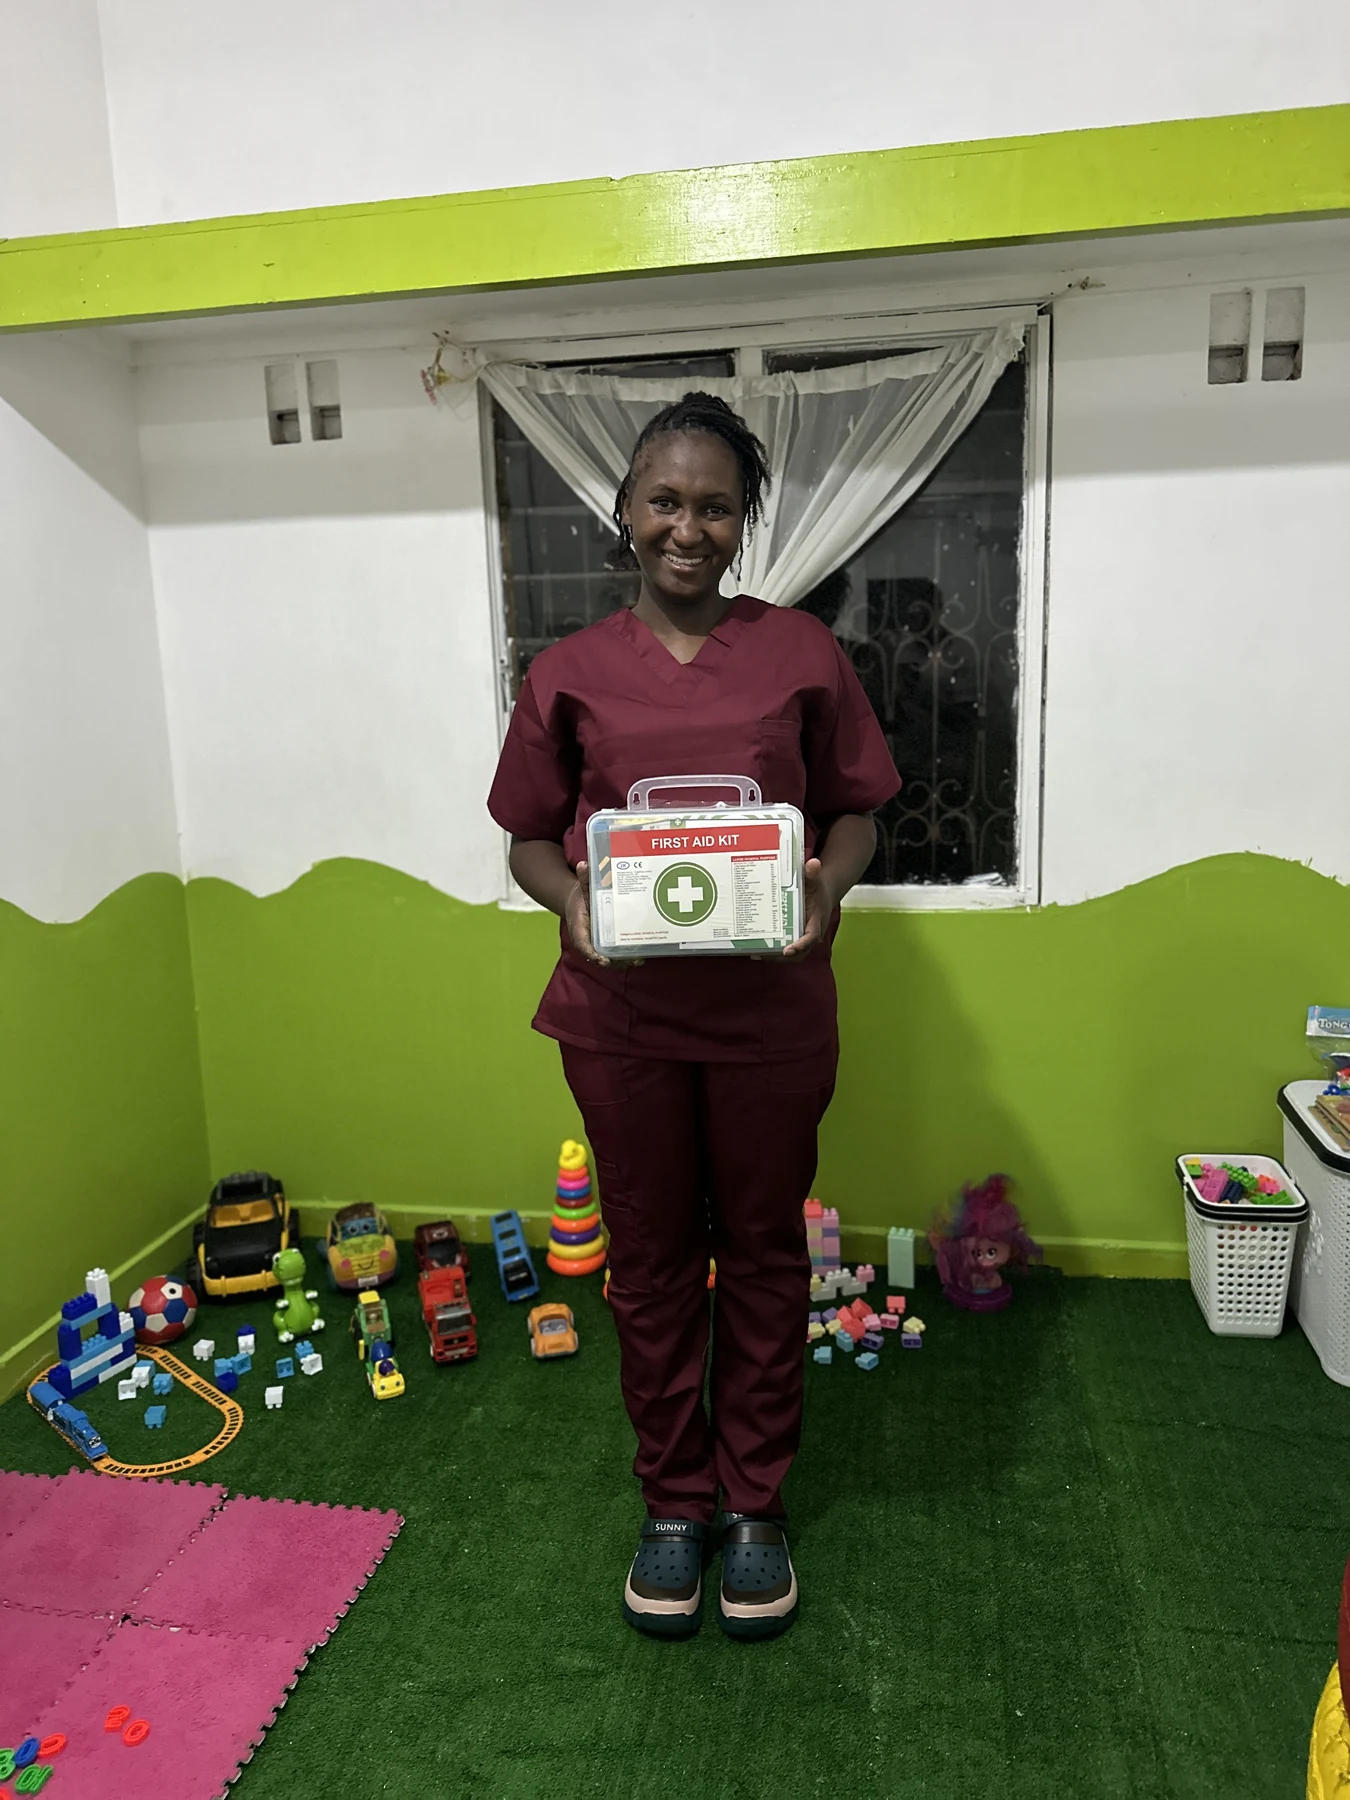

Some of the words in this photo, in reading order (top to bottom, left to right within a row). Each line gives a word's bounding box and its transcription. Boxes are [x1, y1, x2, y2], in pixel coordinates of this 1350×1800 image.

[652, 837, 690, 849] FIRST
[692, 835, 715, 847] AID
[718, 834, 739, 846] KIT
[1317, 1017, 1350, 1029] TONG
[655, 1523, 687, 1532] SUNNY
